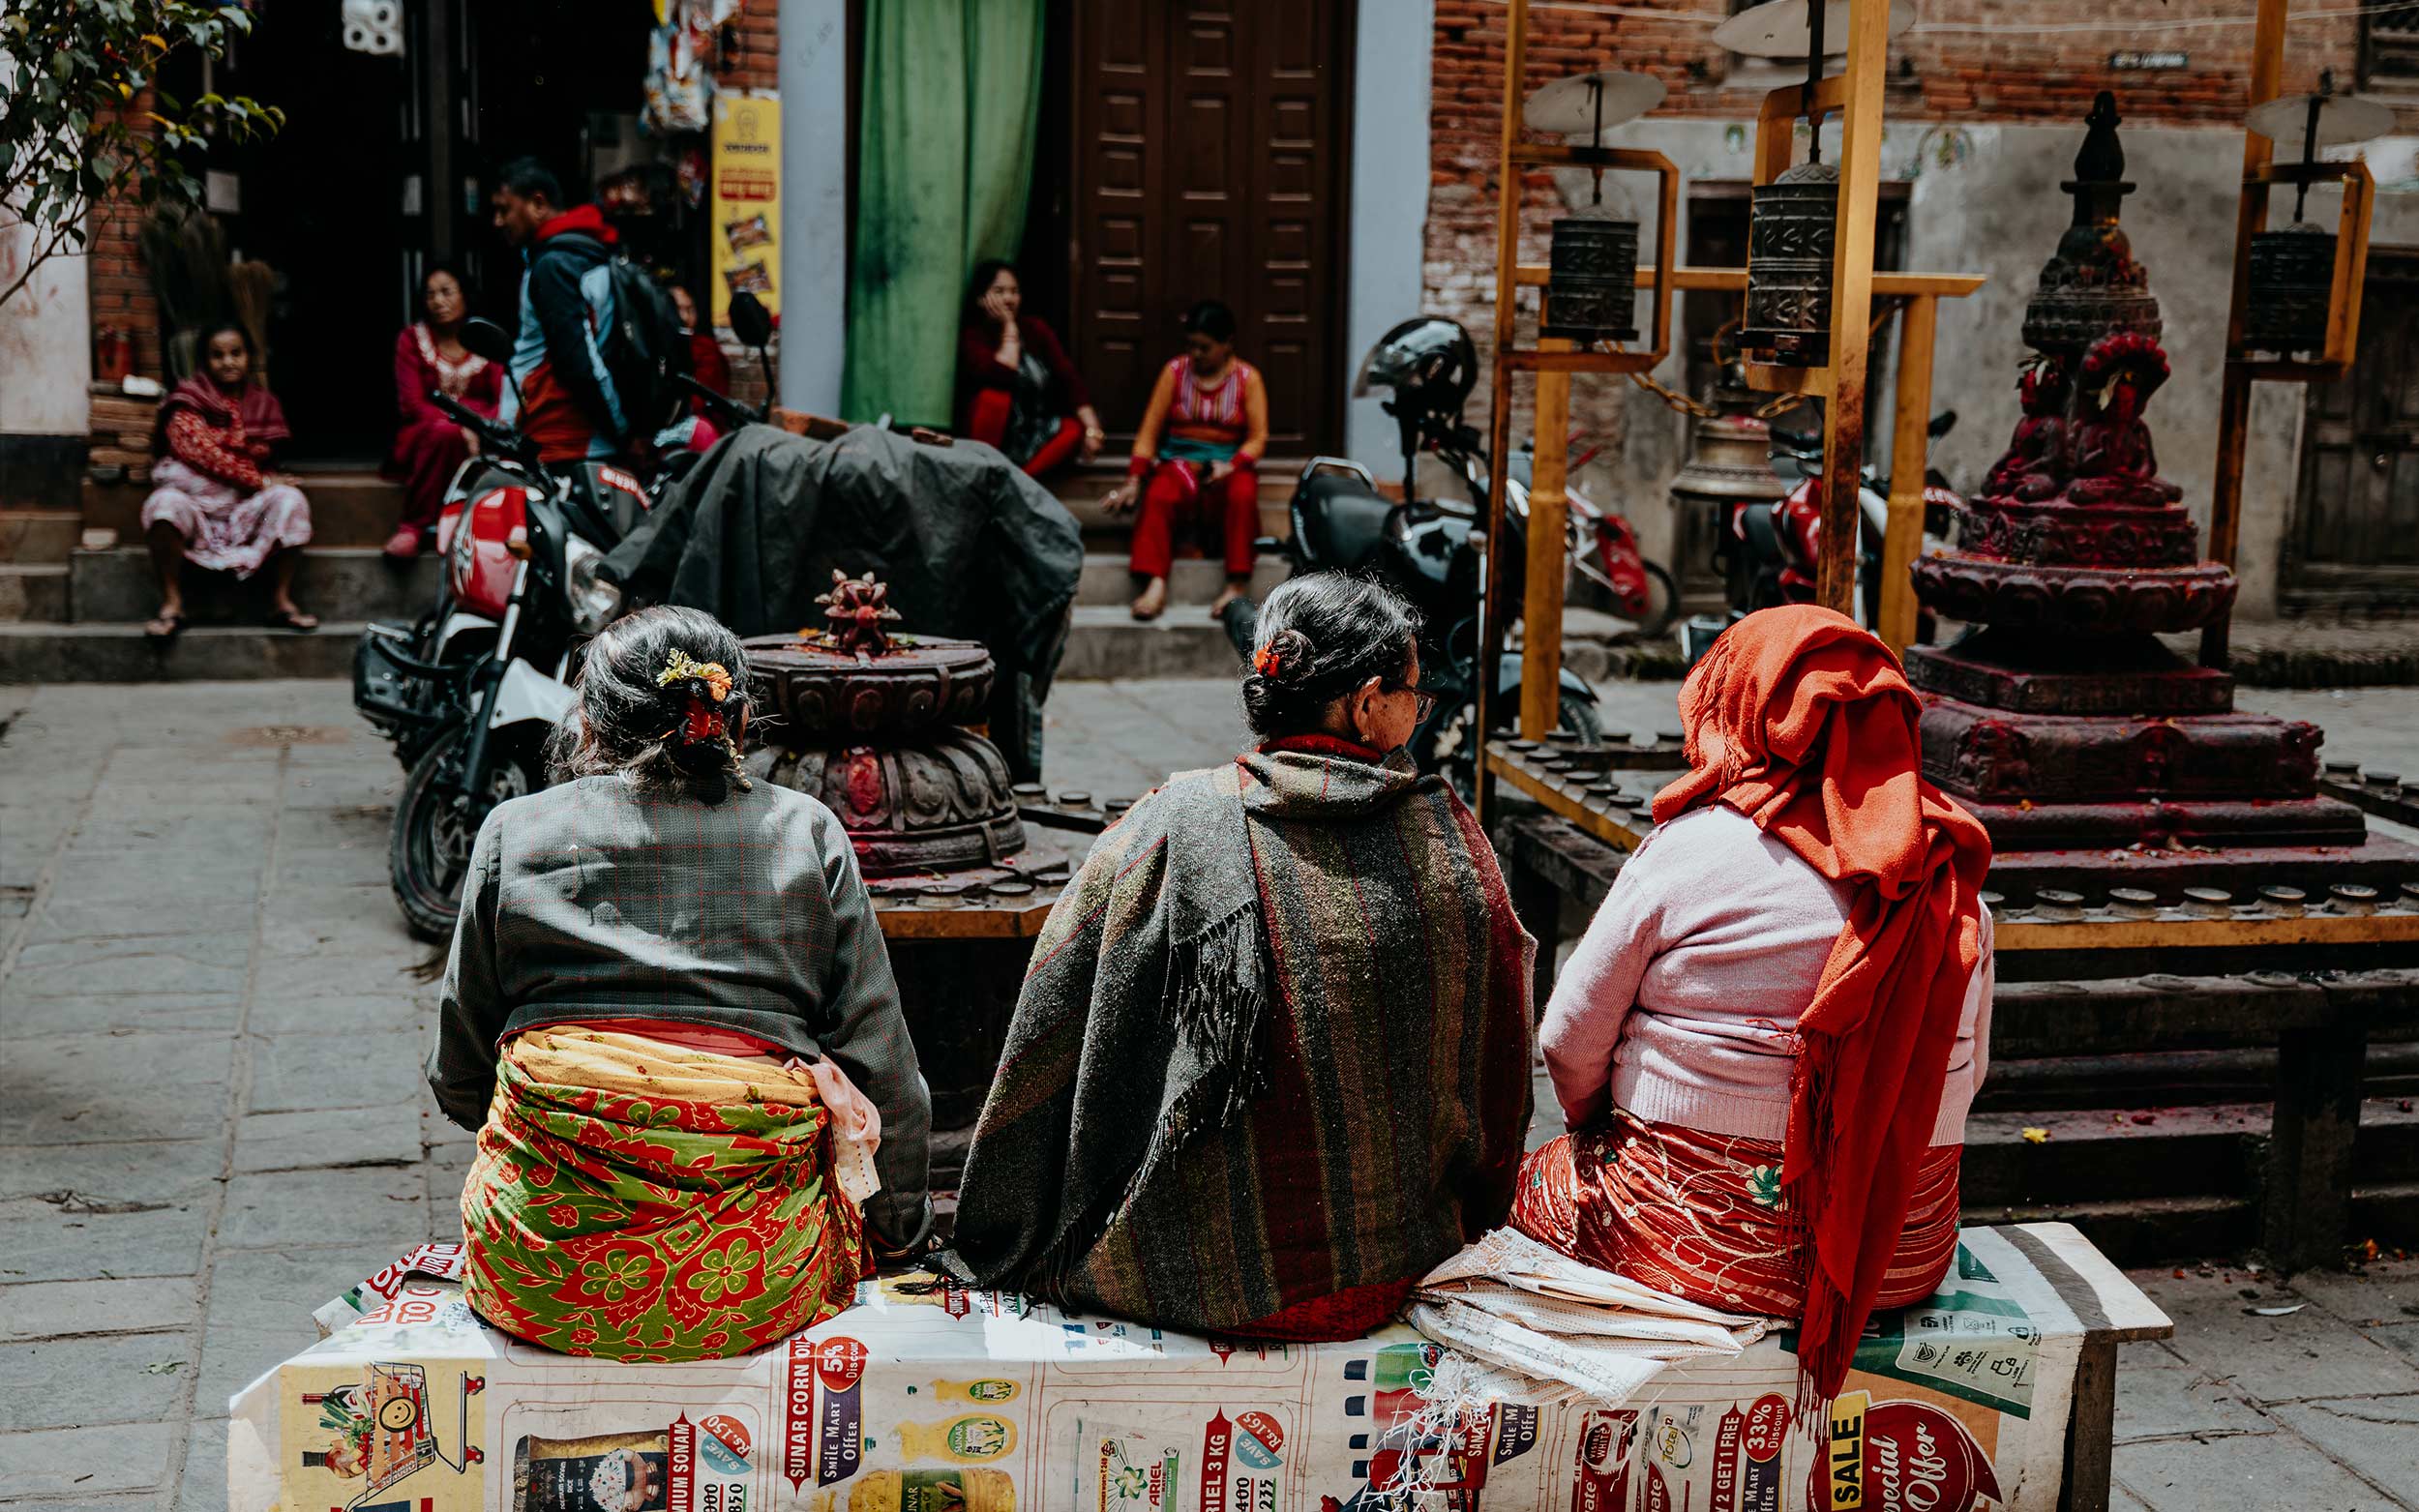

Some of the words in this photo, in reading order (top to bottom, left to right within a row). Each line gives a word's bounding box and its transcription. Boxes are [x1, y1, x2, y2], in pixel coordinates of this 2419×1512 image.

[822, 1344, 845, 1373] 5%
[845, 1342, 859, 1379] Discount
[791, 1364, 810, 1416] CORN
[705, 1414, 752, 1456] Rs.150
[953, 1424, 964, 1453] SUNAR
[1242, 1411, 1282, 1448] Rs.165
[1590, 1429, 1601, 1459] VISIBLE
[1596, 1426, 1611, 1459] WHITE
[1661, 1426, 1679, 1463] Total
[1719, 1417, 1740, 1448] FREE
[1746, 1404, 1773, 1450] 33%
[1767, 1403, 1786, 1449] Discount
[672, 1423, 691, 1473] SONAM
[704, 1441, 741, 1471] SAVE
[790, 1420, 807, 1478] SUNAR
[1208, 1434, 1227, 1457] KG
[1239, 1438, 1271, 1466] SAVE
[1831, 1415, 1862, 1503] SALE
[1149, 1461, 1162, 1507] ARIEL
[1207, 1461, 1223, 1471] 3
[1717, 1461, 1733, 1490] GET
[1903, 1421, 1948, 1512] Offer
[1258, 1479, 1274, 1510] 235
